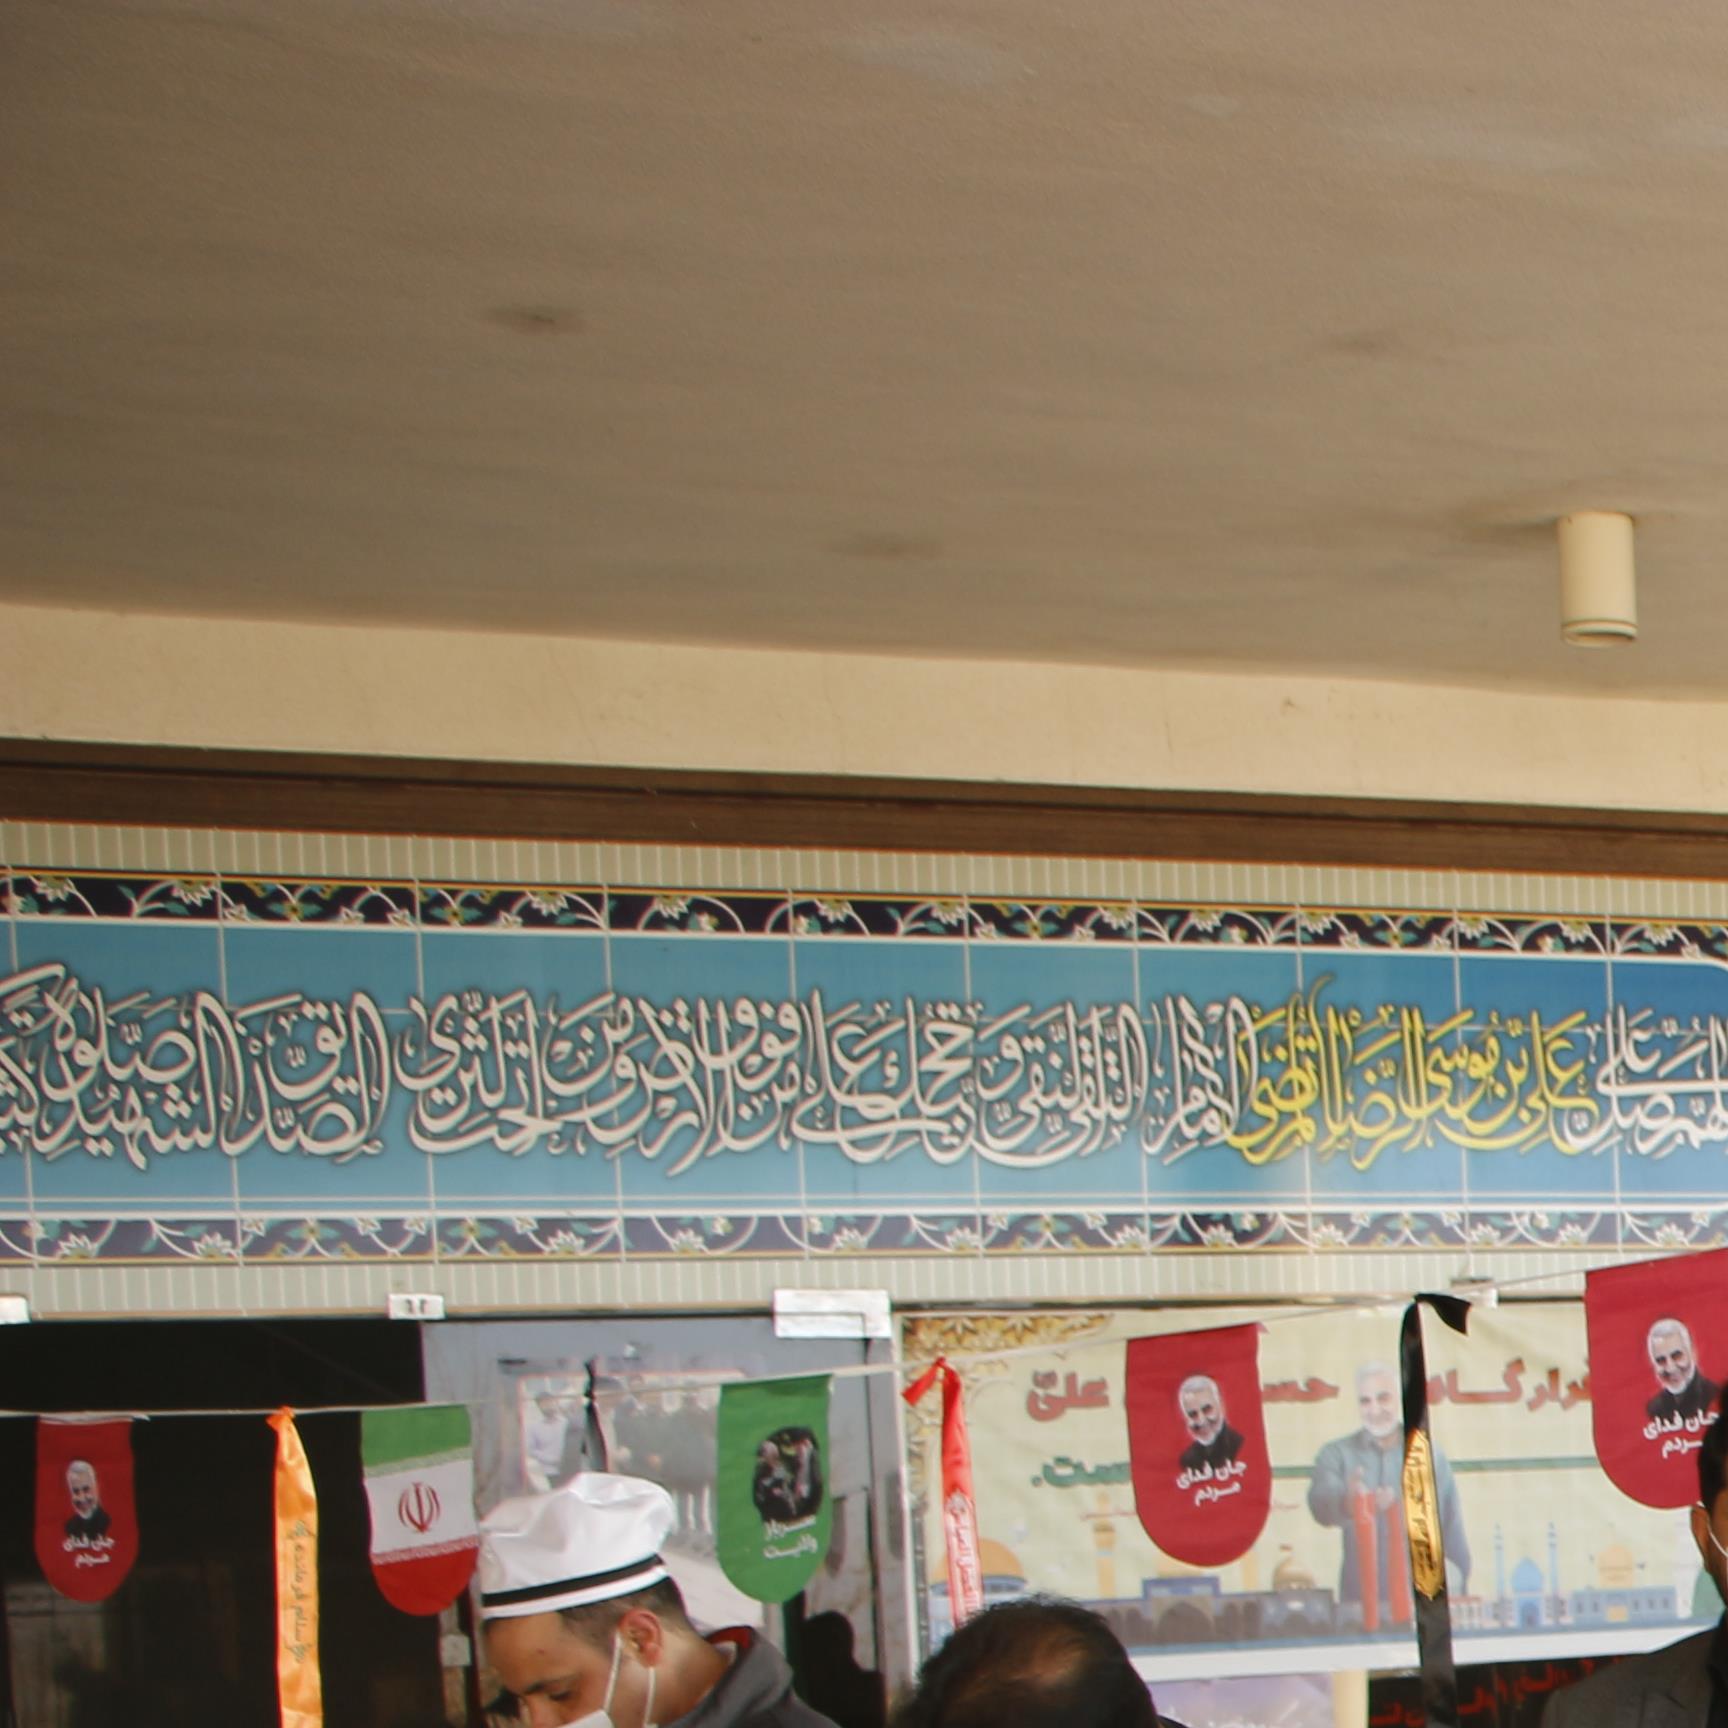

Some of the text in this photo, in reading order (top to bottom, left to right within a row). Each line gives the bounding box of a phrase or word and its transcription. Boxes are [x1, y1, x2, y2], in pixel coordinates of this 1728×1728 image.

[1176, 1458, 1247, 1490] جان فدای
[1195, 1482, 1242, 1508] مردم
